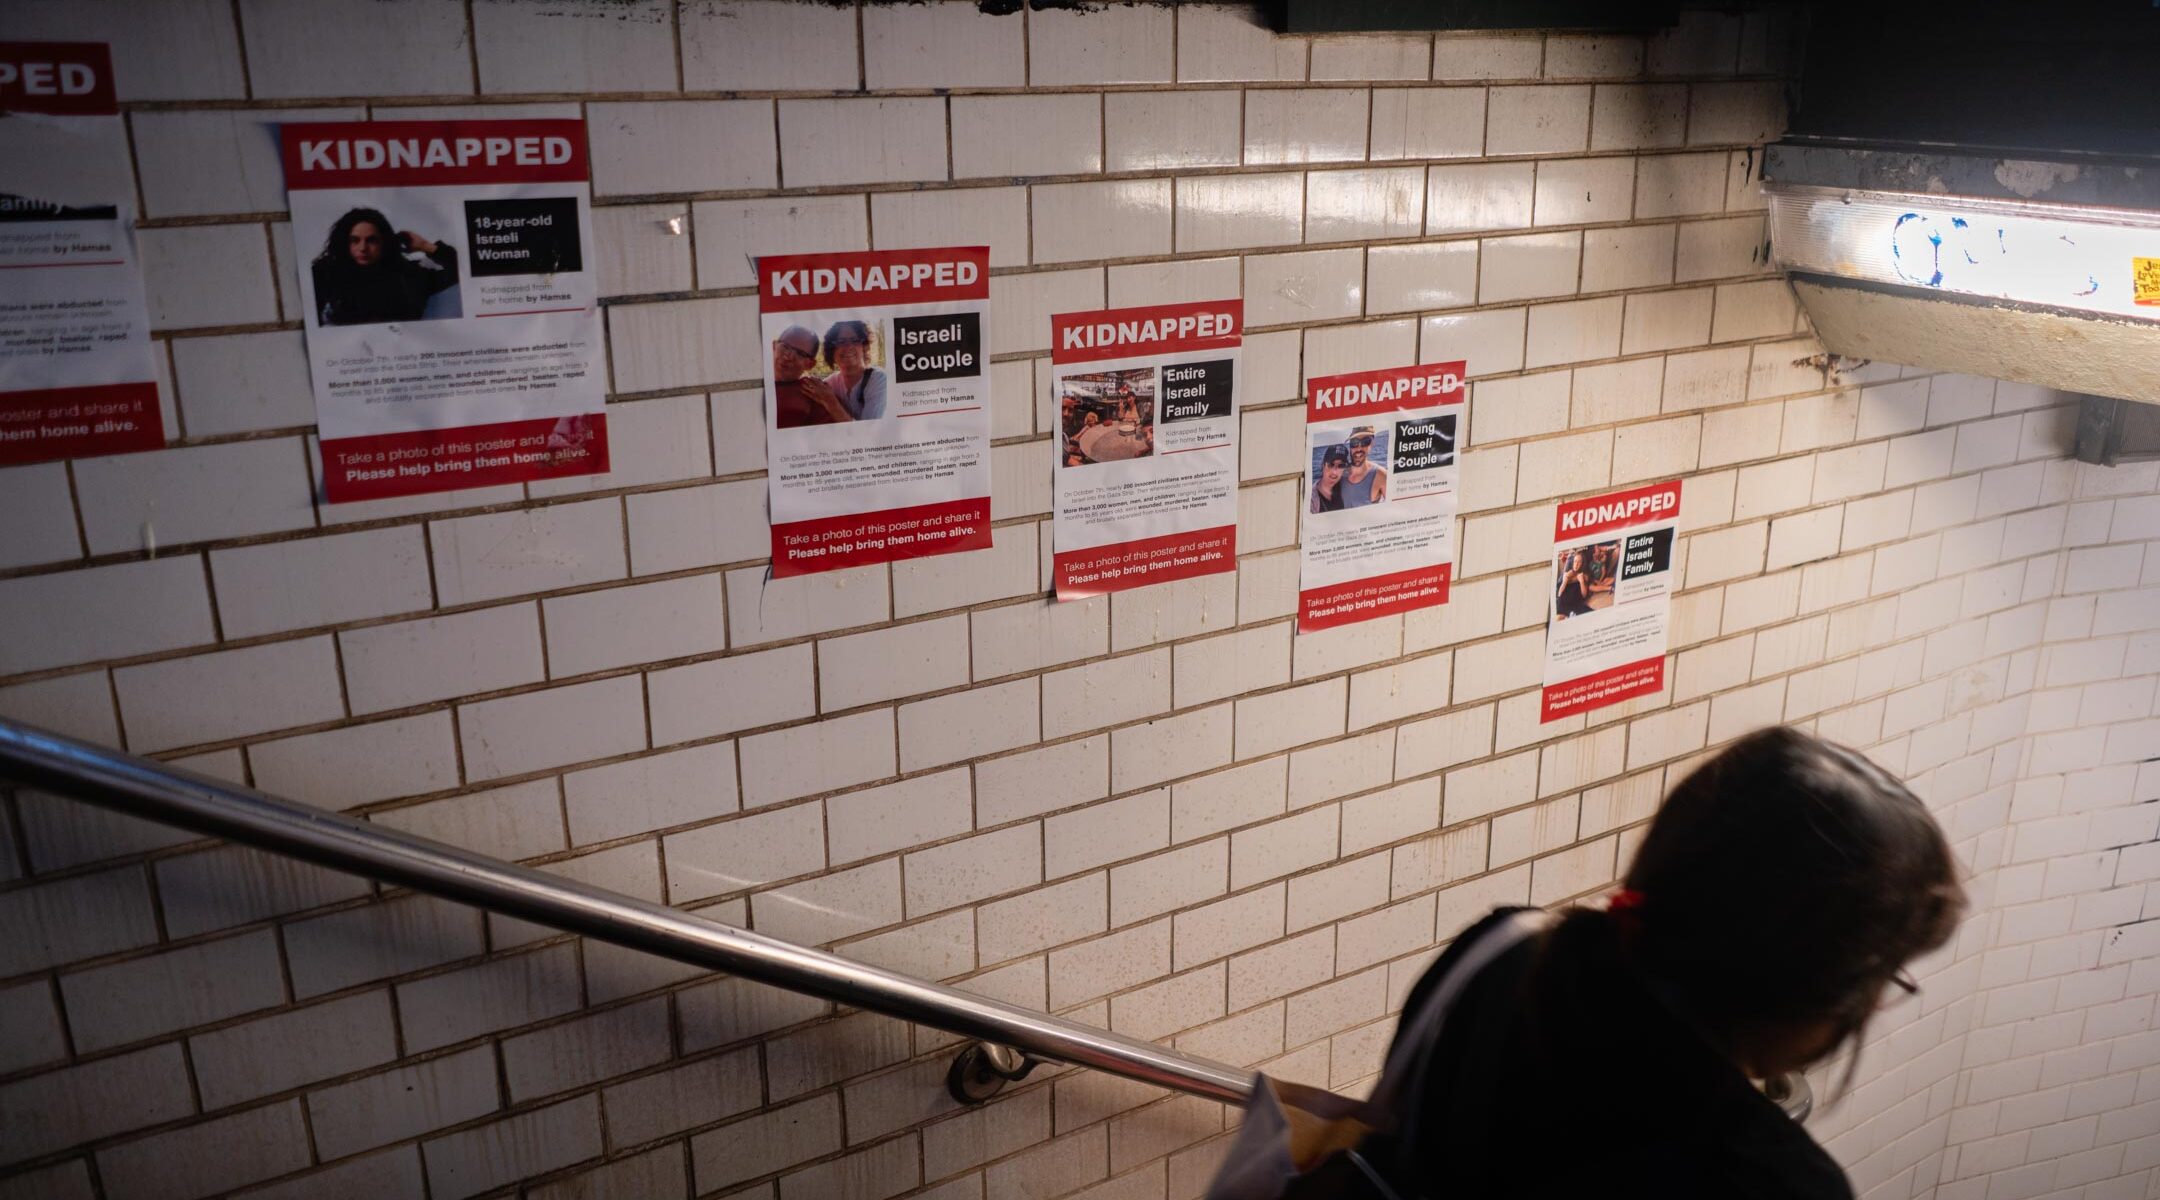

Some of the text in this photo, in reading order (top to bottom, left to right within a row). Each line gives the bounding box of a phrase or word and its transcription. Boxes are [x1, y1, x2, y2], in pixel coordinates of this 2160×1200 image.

[300, 137, 572, 171] KIDNAPPED
[474, 214, 553, 231] 18-year-old
[476, 232, 519, 245] Israeli
[476, 249, 530, 261] Woman
[771, 261, 979, 297] KIDNAPPED
[526, 295, 538, 304] by
[540, 293, 572, 302] Hamas
[901, 324, 961, 345] Israeli
[1063, 313, 1234, 350] KIDNAPPED
[901, 350, 973, 372] Couple
[1167, 367, 1206, 382] Entire
[902, 386, 958, 398] Kidnapped from
[902, 399, 919, 407] their
[940, 396, 949, 404] by
[950, 394, 975, 402] Hamas
[1166, 384, 1206, 400] Israeli
[1315, 373, 1458, 410] KIDNAPPED
[1166, 401, 1209, 418] Family
[40, 423, 89, 438] home
[94, 419, 139, 434] alive.
[1206, 432, 1226, 440] Hamas
[1400, 423, 1436, 437] Young
[337, 451, 372, 466] Take
[375, 452, 385, 463] a
[389, 446, 429, 463] photo
[431, 443, 445, 457] of
[447, 441, 472, 455] this
[475, 437, 516, 455] poster
[519, 433, 545, 447] and
[1398, 437, 1433, 453] Israeli
[346, 447, 590, 482] Please help bring them home alive.
[1398, 454, 1438, 468] Couple
[1561, 491, 1676, 531] KIDNAPPED
[784, 510, 980, 546] Take a photo of this poster and share it
[788, 526, 977, 560] Please help bring them home alive.
[1628, 535, 1654, 549] Entire
[1064, 562, 1085, 573] Take
[1096, 556, 1121, 569] photo
[1123, 553, 1132, 563] of
[1133, 551, 1149, 561] this
[1150, 547, 1177, 560] poster
[1178, 543, 1196, 553] and
[1197, 540, 1220, 550] share
[1222, 537, 1227, 545] it
[1626, 547, 1653, 562] Israeli
[1068, 551, 1224, 585] Please help bring them home alive.
[1625, 560, 1654, 576] Family
[1306, 599, 1325, 608] Take
[1333, 592, 1354, 603] photo
[1355, 590, 1363, 598] of
[1364, 588, 1377, 596] this
[1379, 584, 1402, 595] poster
[1402, 580, 1417, 589] and
[1418, 576, 1438, 586] share
[1309, 587, 1440, 619] Please help bring them home alive.
[1548, 692, 1563, 701] Take
[1569, 685, 1587, 696] photo
[1594, 680, 1605, 688] this
[1606, 675, 1625, 687] poster
[1625, 671, 1637, 679] and
[1638, 667, 1654, 676] share
[1549, 676, 1656, 711] Please help bring them home alive.
